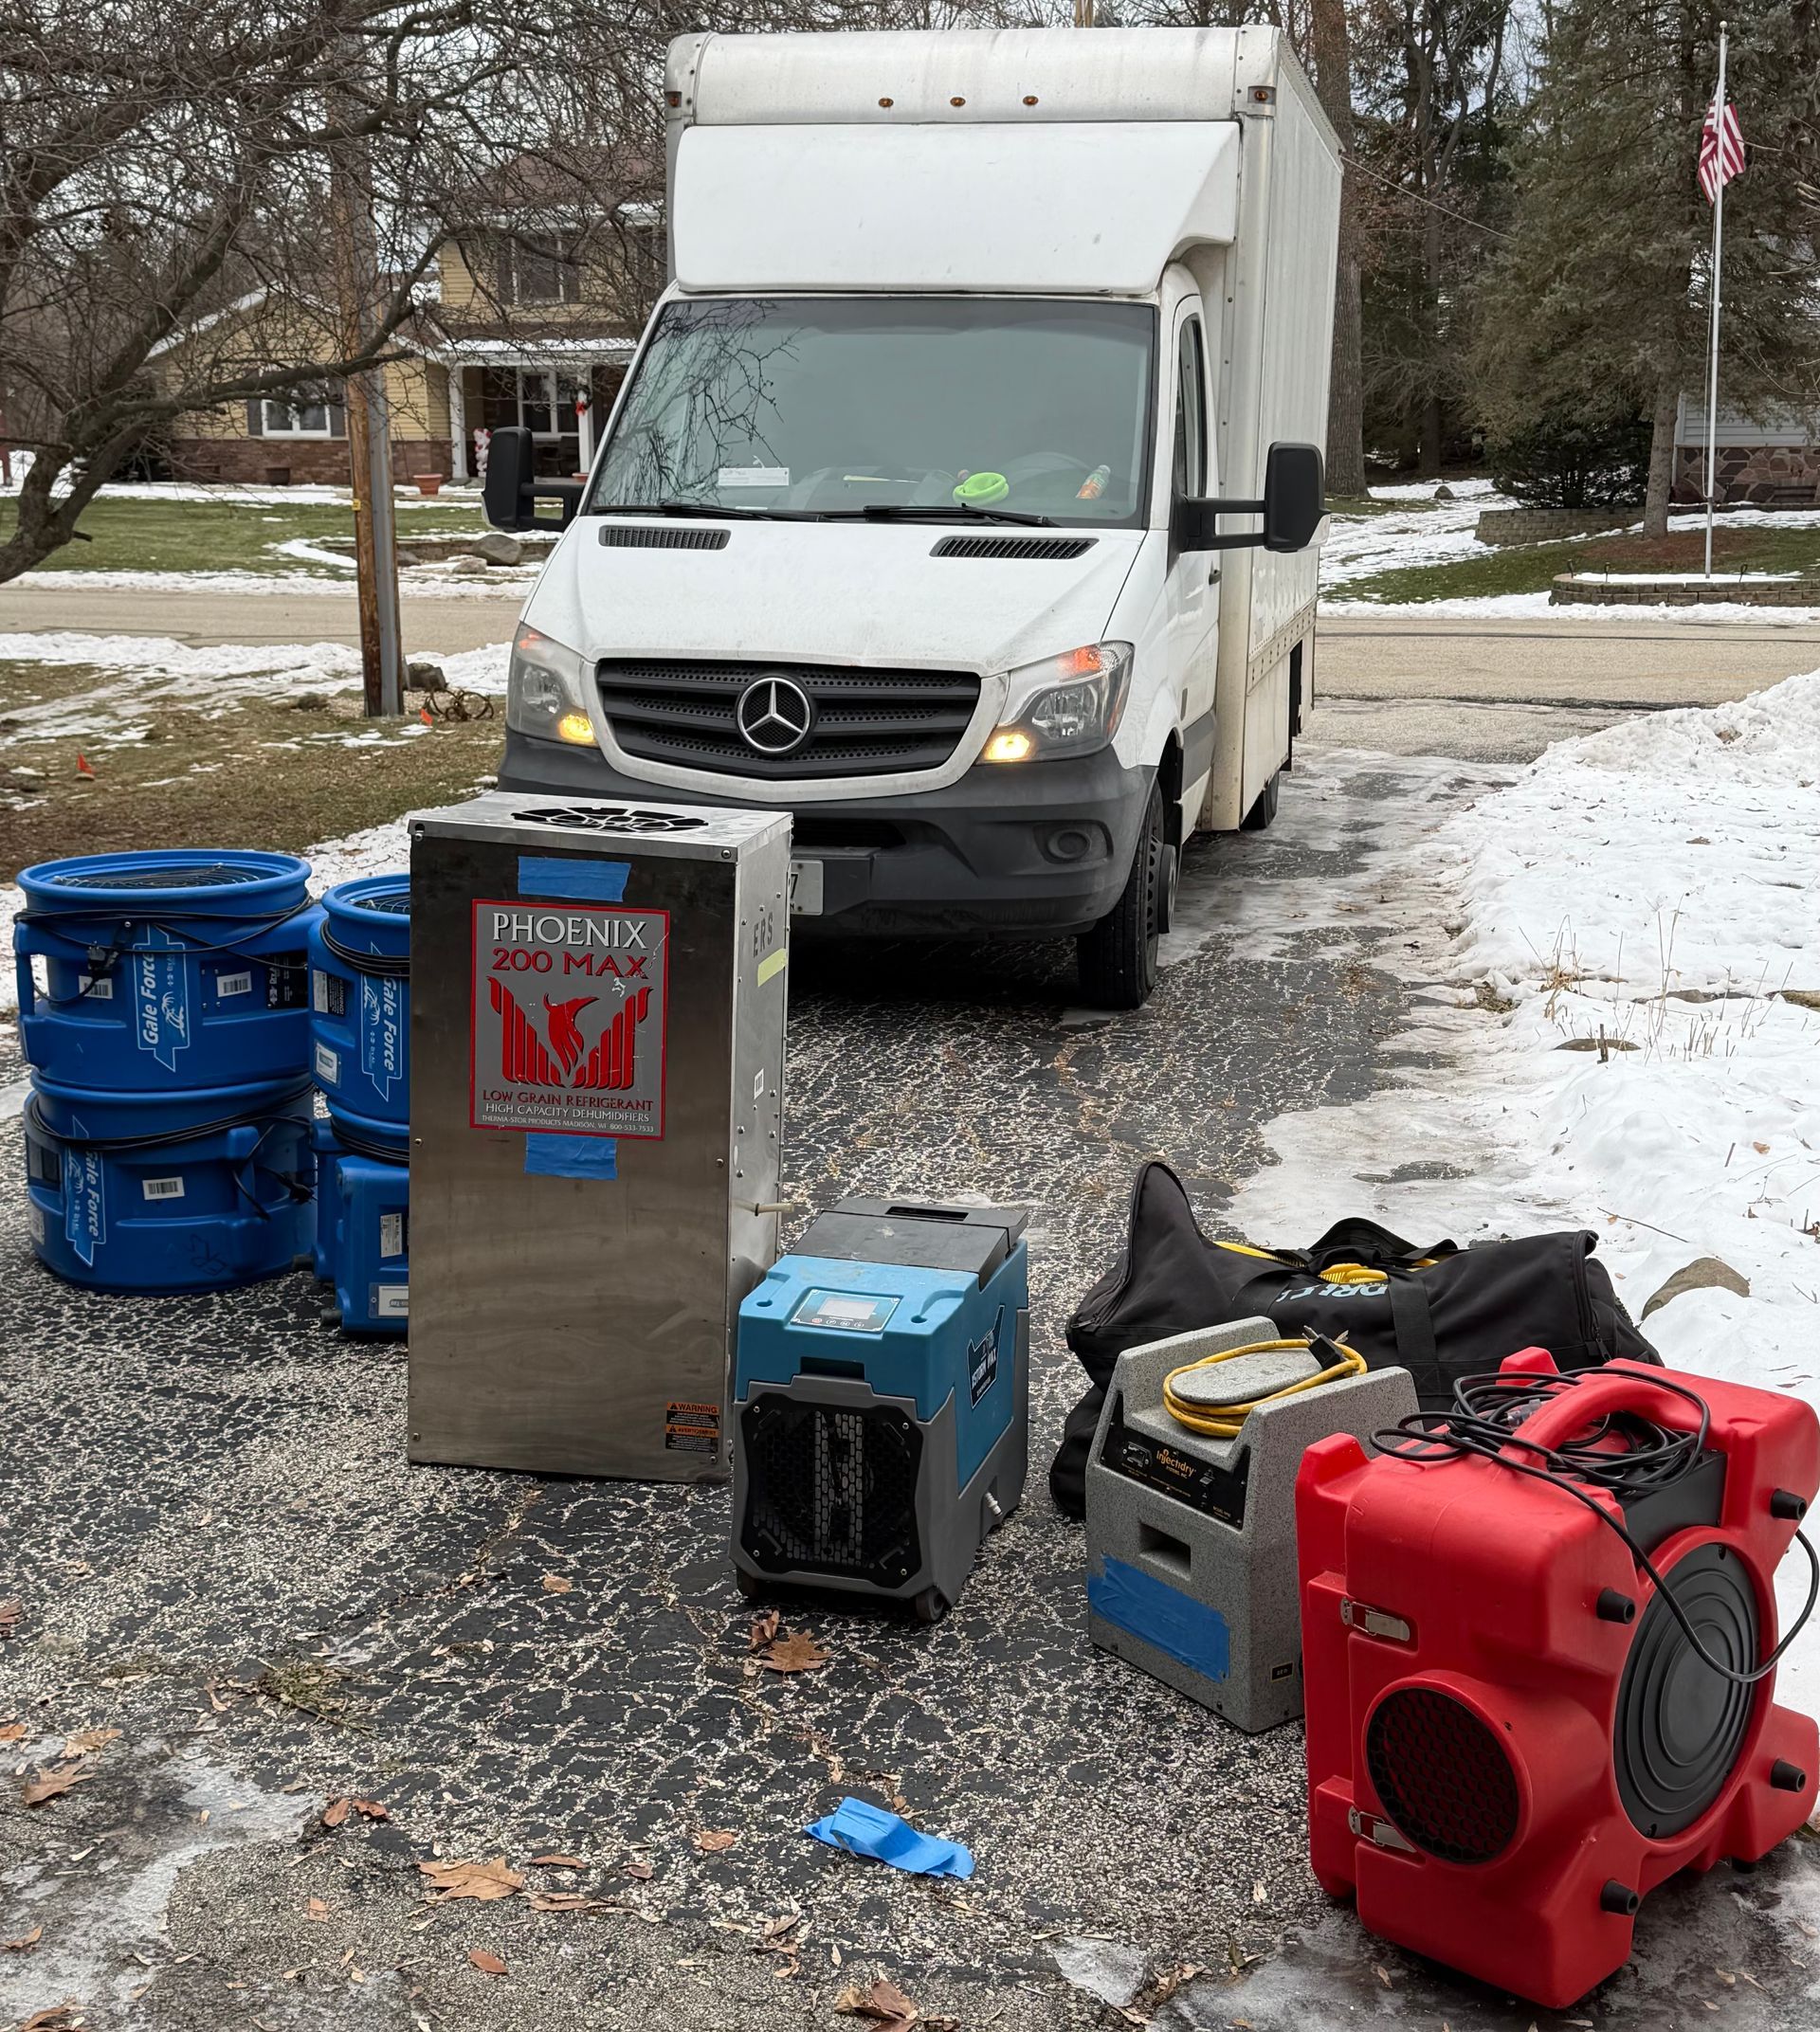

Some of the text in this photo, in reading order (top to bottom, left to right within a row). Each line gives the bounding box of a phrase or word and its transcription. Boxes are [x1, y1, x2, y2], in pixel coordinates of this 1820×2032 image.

[493, 912, 648, 950] PHOENIX
[754, 912, 774, 958] ERS
[492, 947, 649, 980] 200 MAX
[140, 952, 159, 1044] Gale Force
[383, 976, 397, 1071] Gale Force
[482, 1090, 654, 1112] LOW GRAIN REFRIGERANT
[485, 1102, 650, 1122] HIGH CAPACITY DEHUMIDIFIERS
[482, 1115, 527, 1124] THERMA-STOR
[528, 1117, 562, 1127] PRODUCTS
[610, 1123, 654, 1133] 800-533-7533
[87, 1188, 100, 1237] Force
[678, 1404, 718, 1413] WARNING
